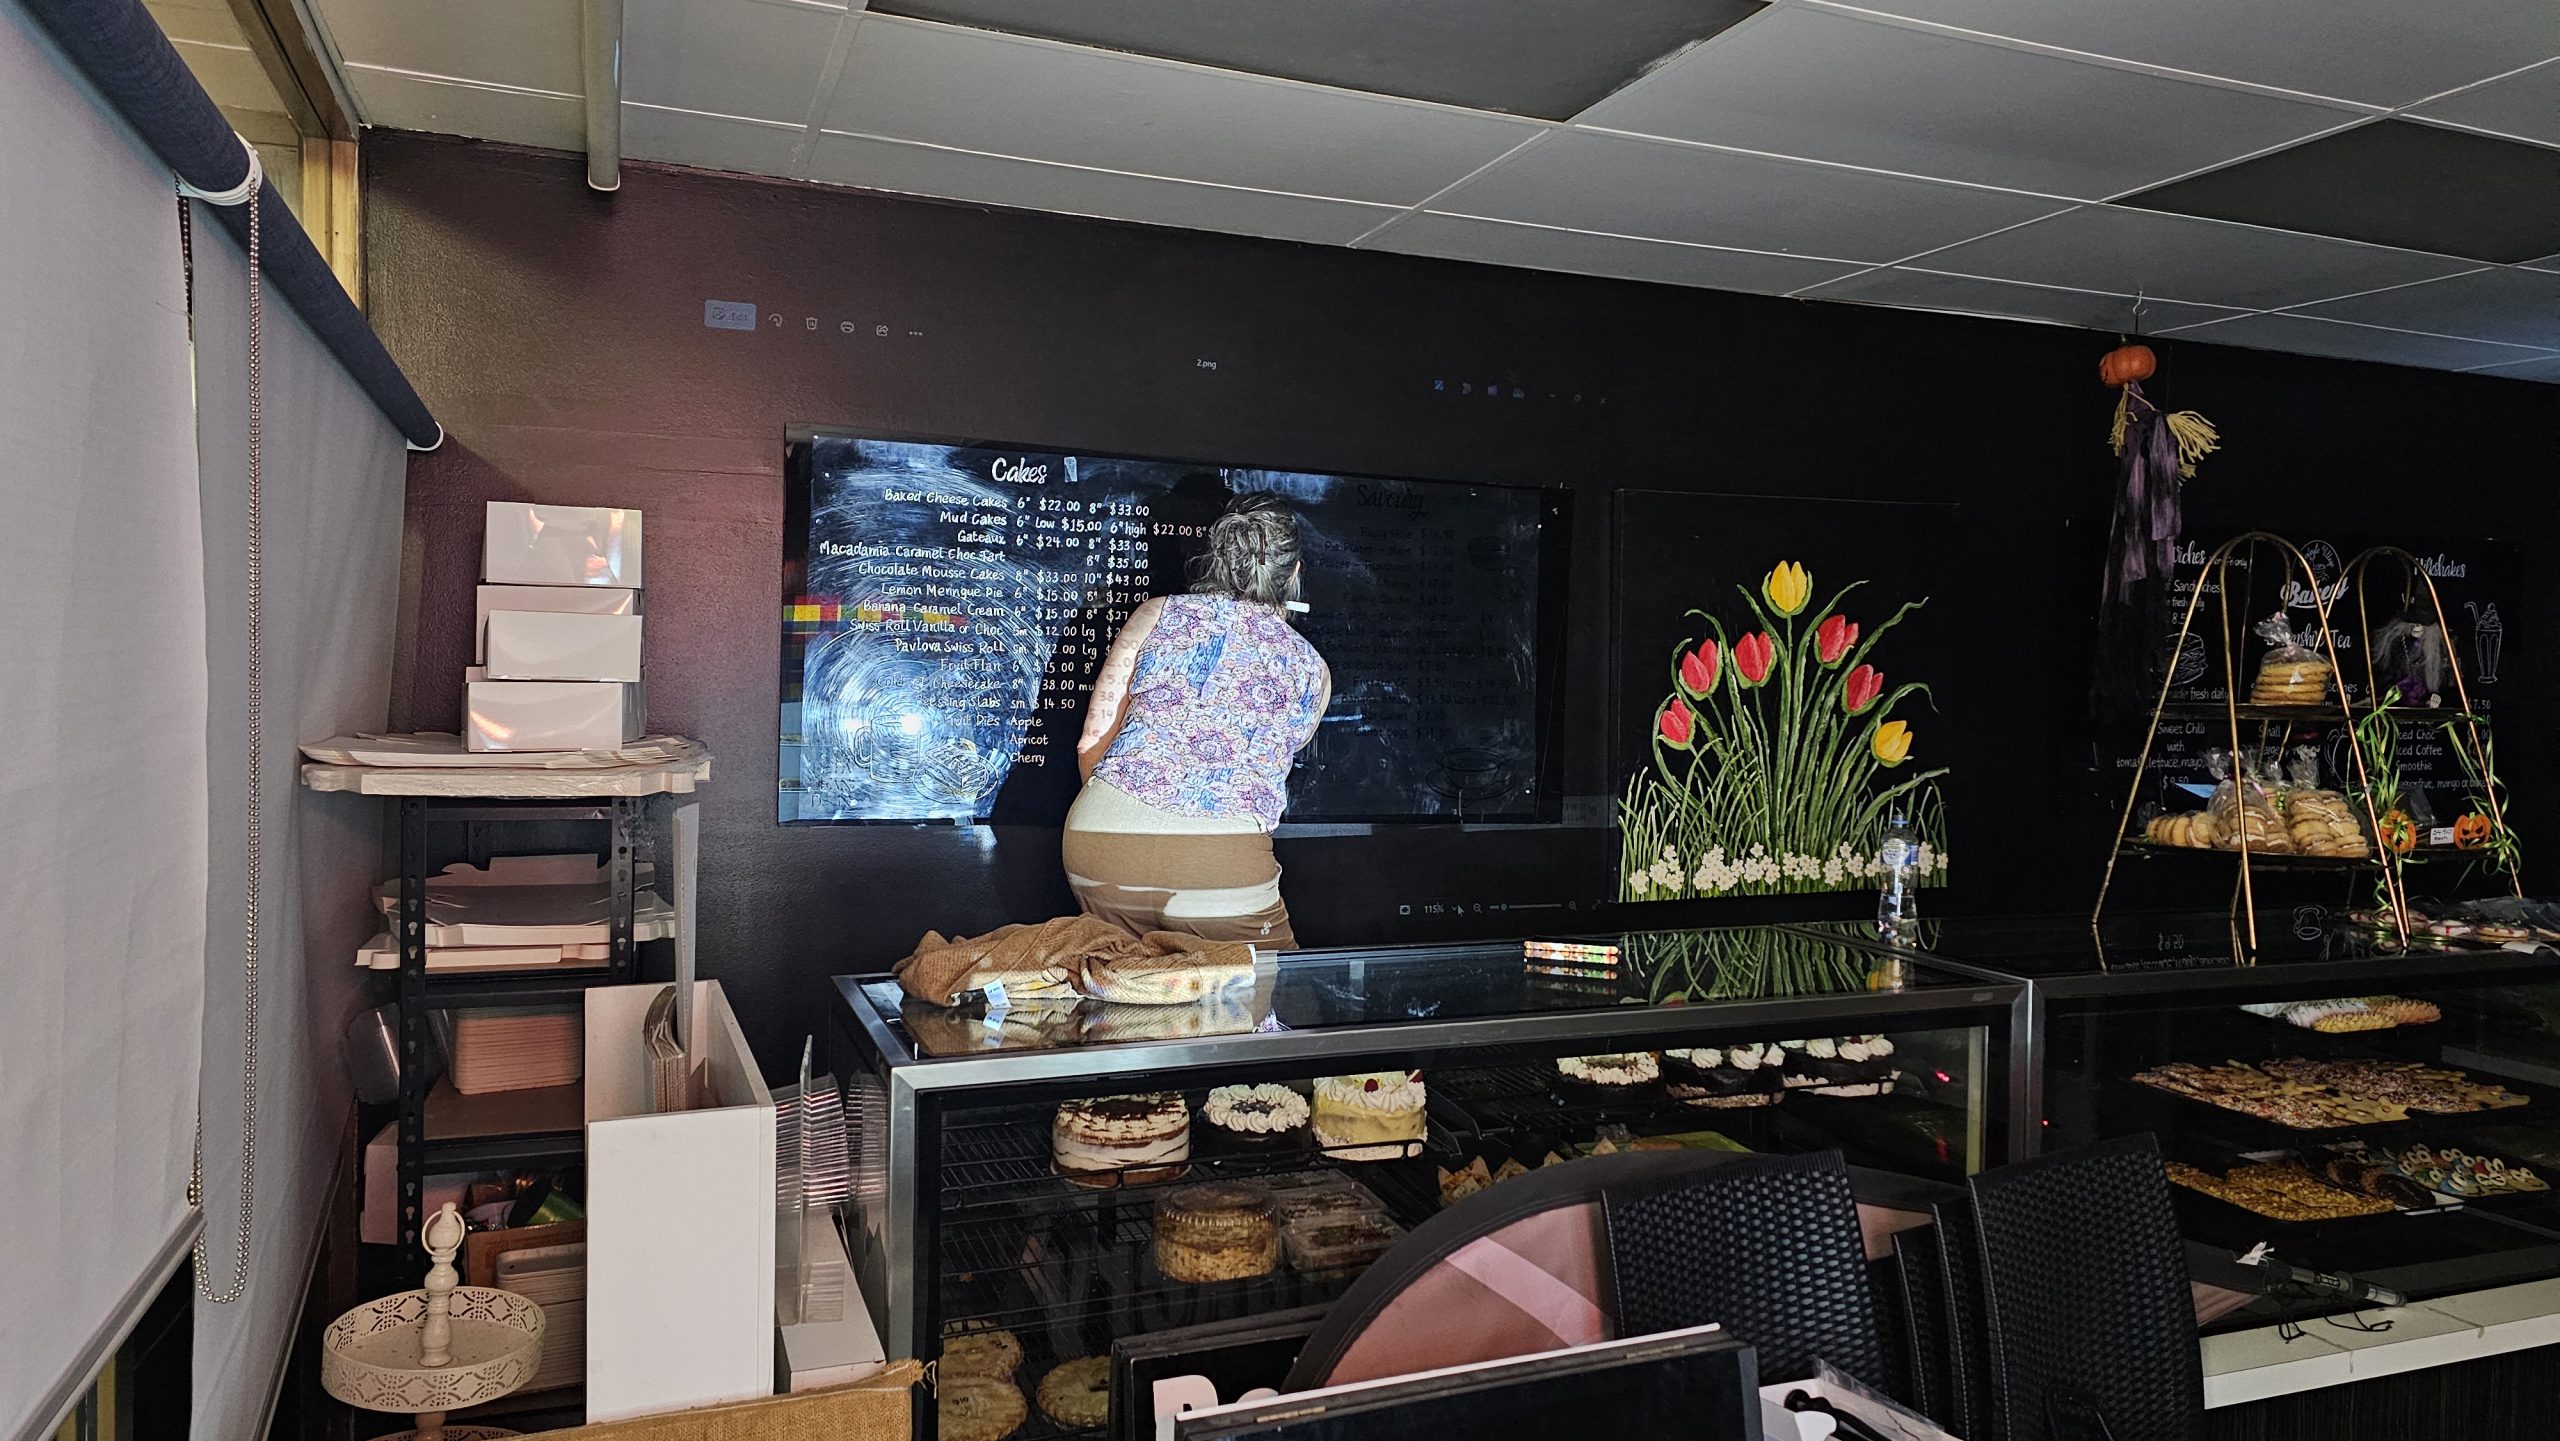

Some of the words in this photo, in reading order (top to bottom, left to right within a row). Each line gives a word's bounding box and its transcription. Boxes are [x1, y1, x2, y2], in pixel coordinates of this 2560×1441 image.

[991, 456, 1047, 485] Cakes
[884, 489, 922, 501] Baked
[926, 491, 969, 505] Cheese
[973, 493, 1007, 508] Cakes
[1017, 497, 1030, 509] 6"
[1039, 497, 1081, 512] $22.00
[1109, 502, 1150, 517] $33.00
[940, 511, 967, 523] Mud
[972, 512, 1007, 526] Cakes
[1062, 517, 1102, 533] $15.00
[1152, 524, 1192, 537] $22.00
[957, 530, 1006, 545] Gateaux
[1036, 535, 1080, 550] $24.00
[819, 541, 890, 557] Macadamia
[896, 546, 944, 559] Caramel
[948, 547, 975, 560] Choc
[1107, 555, 1149, 569] $35.00
[858, 563, 918, 575] Chocolate
[921, 565, 966, 578] Mousse
[970, 568, 1005, 581] Cakes
[1036, 570, 1077, 584] $33.00
[882, 583, 922, 596] Lemon
[926, 584, 981, 600] Meringue
[986, 587, 1004, 599] Pie
[2174, 579, 2221, 593] Sandches
[863, 600, 906, 613] Banana
[913, 602, 962, 616] Caramel
[967, 604, 1004, 617] Cream
[1035, 607, 1078, 621] $15.00
[850, 619, 880, 632] Swiss
[885, 620, 910, 632] Roll
[913, 619, 956, 633] Vanilla
[959, 625, 968, 634] or
[975, 624, 1004, 636] Choc
[1035, 624, 1077, 637] $12.00
[895, 638, 942, 653] Pavlova
[944, 640, 974, 653] Swiss
[979, 640, 1005, 654] Roll
[2331, 629, 2352, 649] Tea
[974, 659, 1001, 671] Flan
[2328, 683, 2358, 693] scnes
[969, 696, 1001, 708] Slabs
[1010, 716, 1043, 731] Apple
[1010, 734, 1049, 747] Apricot
[2397, 730, 2413, 740] ced
[2416, 729, 2436, 740] Choc
[2263, 746, 2280, 758] arge
[2416, 744, 2443, 756] Coffee
[1009, 751, 1046, 766] Cherry
